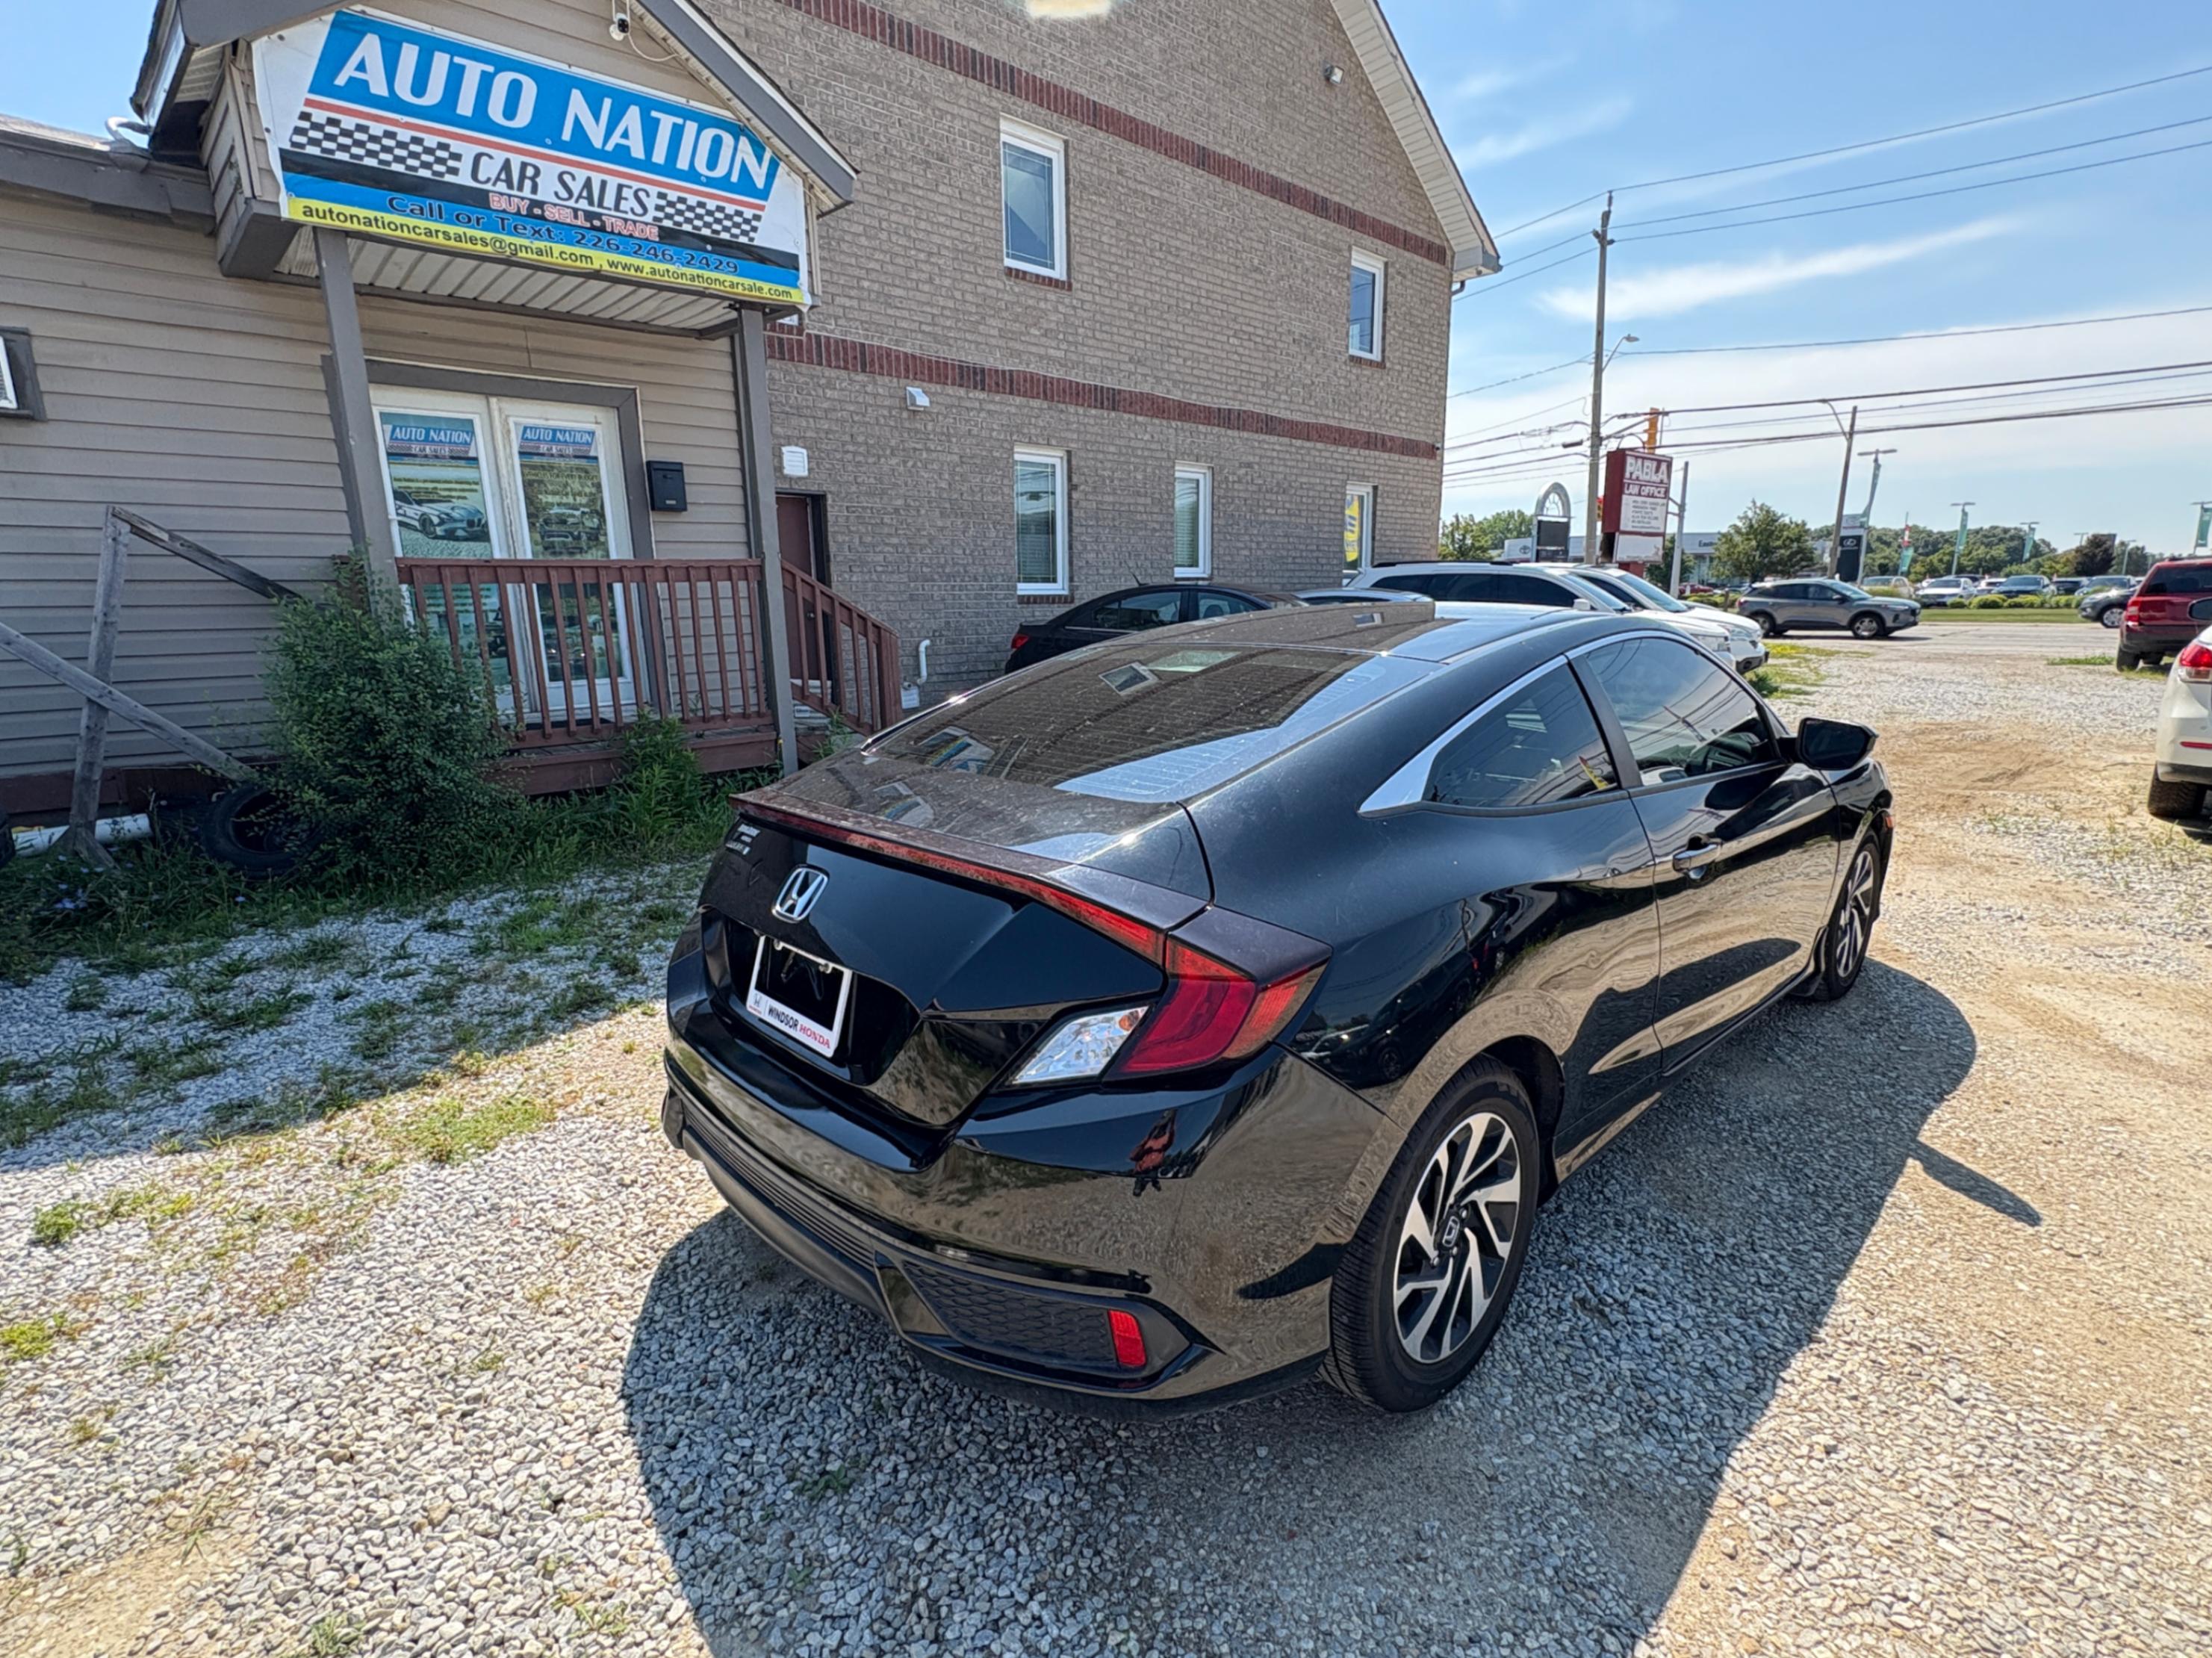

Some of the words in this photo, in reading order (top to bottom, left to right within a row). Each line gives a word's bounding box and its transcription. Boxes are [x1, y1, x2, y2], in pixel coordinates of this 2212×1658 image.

[333, 32, 538, 128] AUTO
[561, 87, 772, 190] NATION
[470, 152, 541, 196] CAR
[553, 170, 650, 217] SALES
[387, 196, 445, 221] Call
[453, 211, 486, 228] or
[494, 214, 565, 243] Text:
[573, 230, 739, 274] 226-246-2429
[488, 192, 530, 215] BUY
[544, 204, 590, 226] SELL
[601, 215, 659, 240] TRADE
[302, 204, 594, 266] autonationcarsales@gmail.com
[607, 258, 793, 299] www.autonationcarsale.com
[393, 426, 425, 441] AUTO
[429, 428, 471, 444] NATION
[524, 428, 553, 441] AUTO
[555, 430, 593, 444] NATION
[1624, 456, 1668, 483] PABLA
[1624, 484, 1638, 494] LAW
[1640, 486, 1665, 497] OFFICE
[768, 1004, 798, 1031] WINDSOR
[800, 1024, 830, 1049] HONDA
